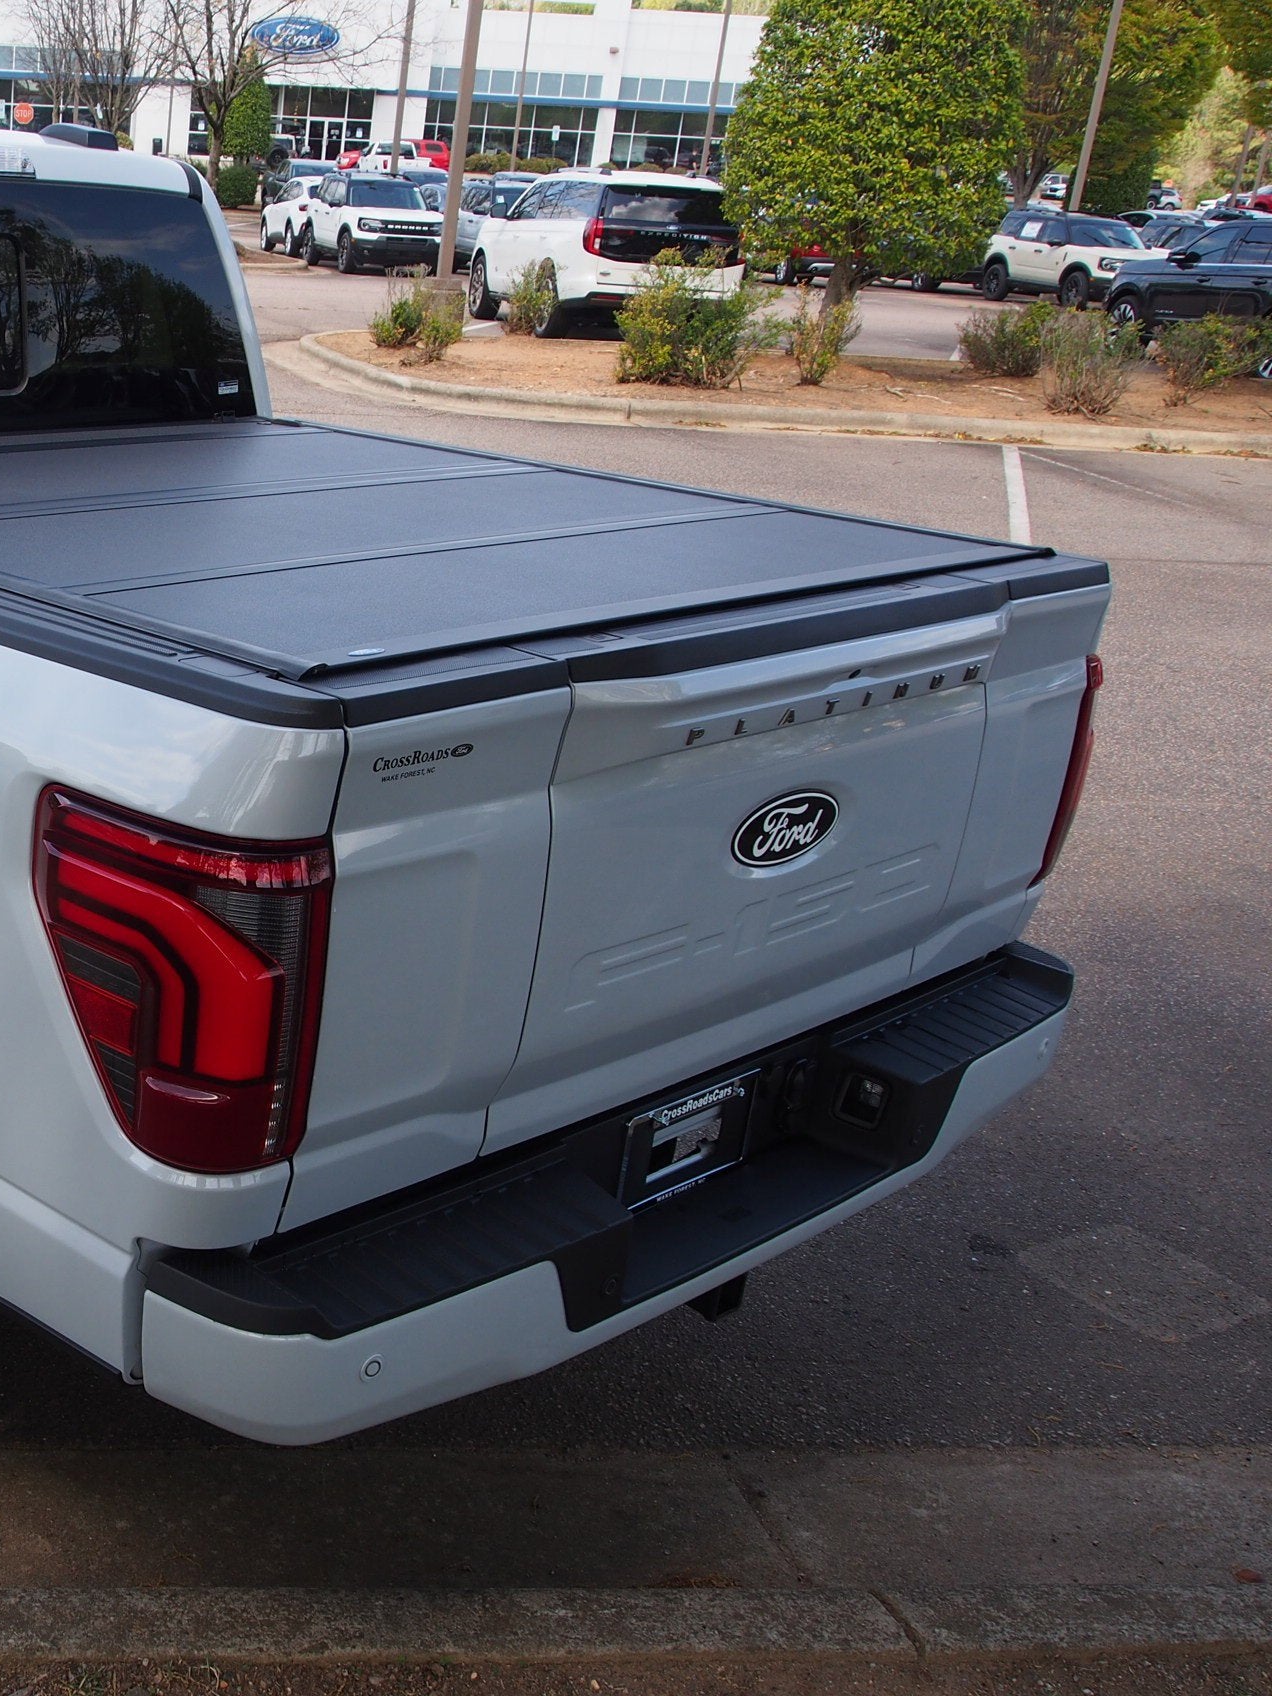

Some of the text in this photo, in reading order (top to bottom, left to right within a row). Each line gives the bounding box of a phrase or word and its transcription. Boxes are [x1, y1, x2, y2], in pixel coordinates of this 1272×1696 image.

[270, 23, 323, 46] Ford
[15, 109, 32, 118] STOP
[640, 230, 707, 240] EXPEDITION
[685, 664, 981, 746] PLATINUM
[381, 774, 399, 783] WAKE
[752, 803, 824, 858] Ford
[661, 1086, 732, 1121] CrossRoadsCars
